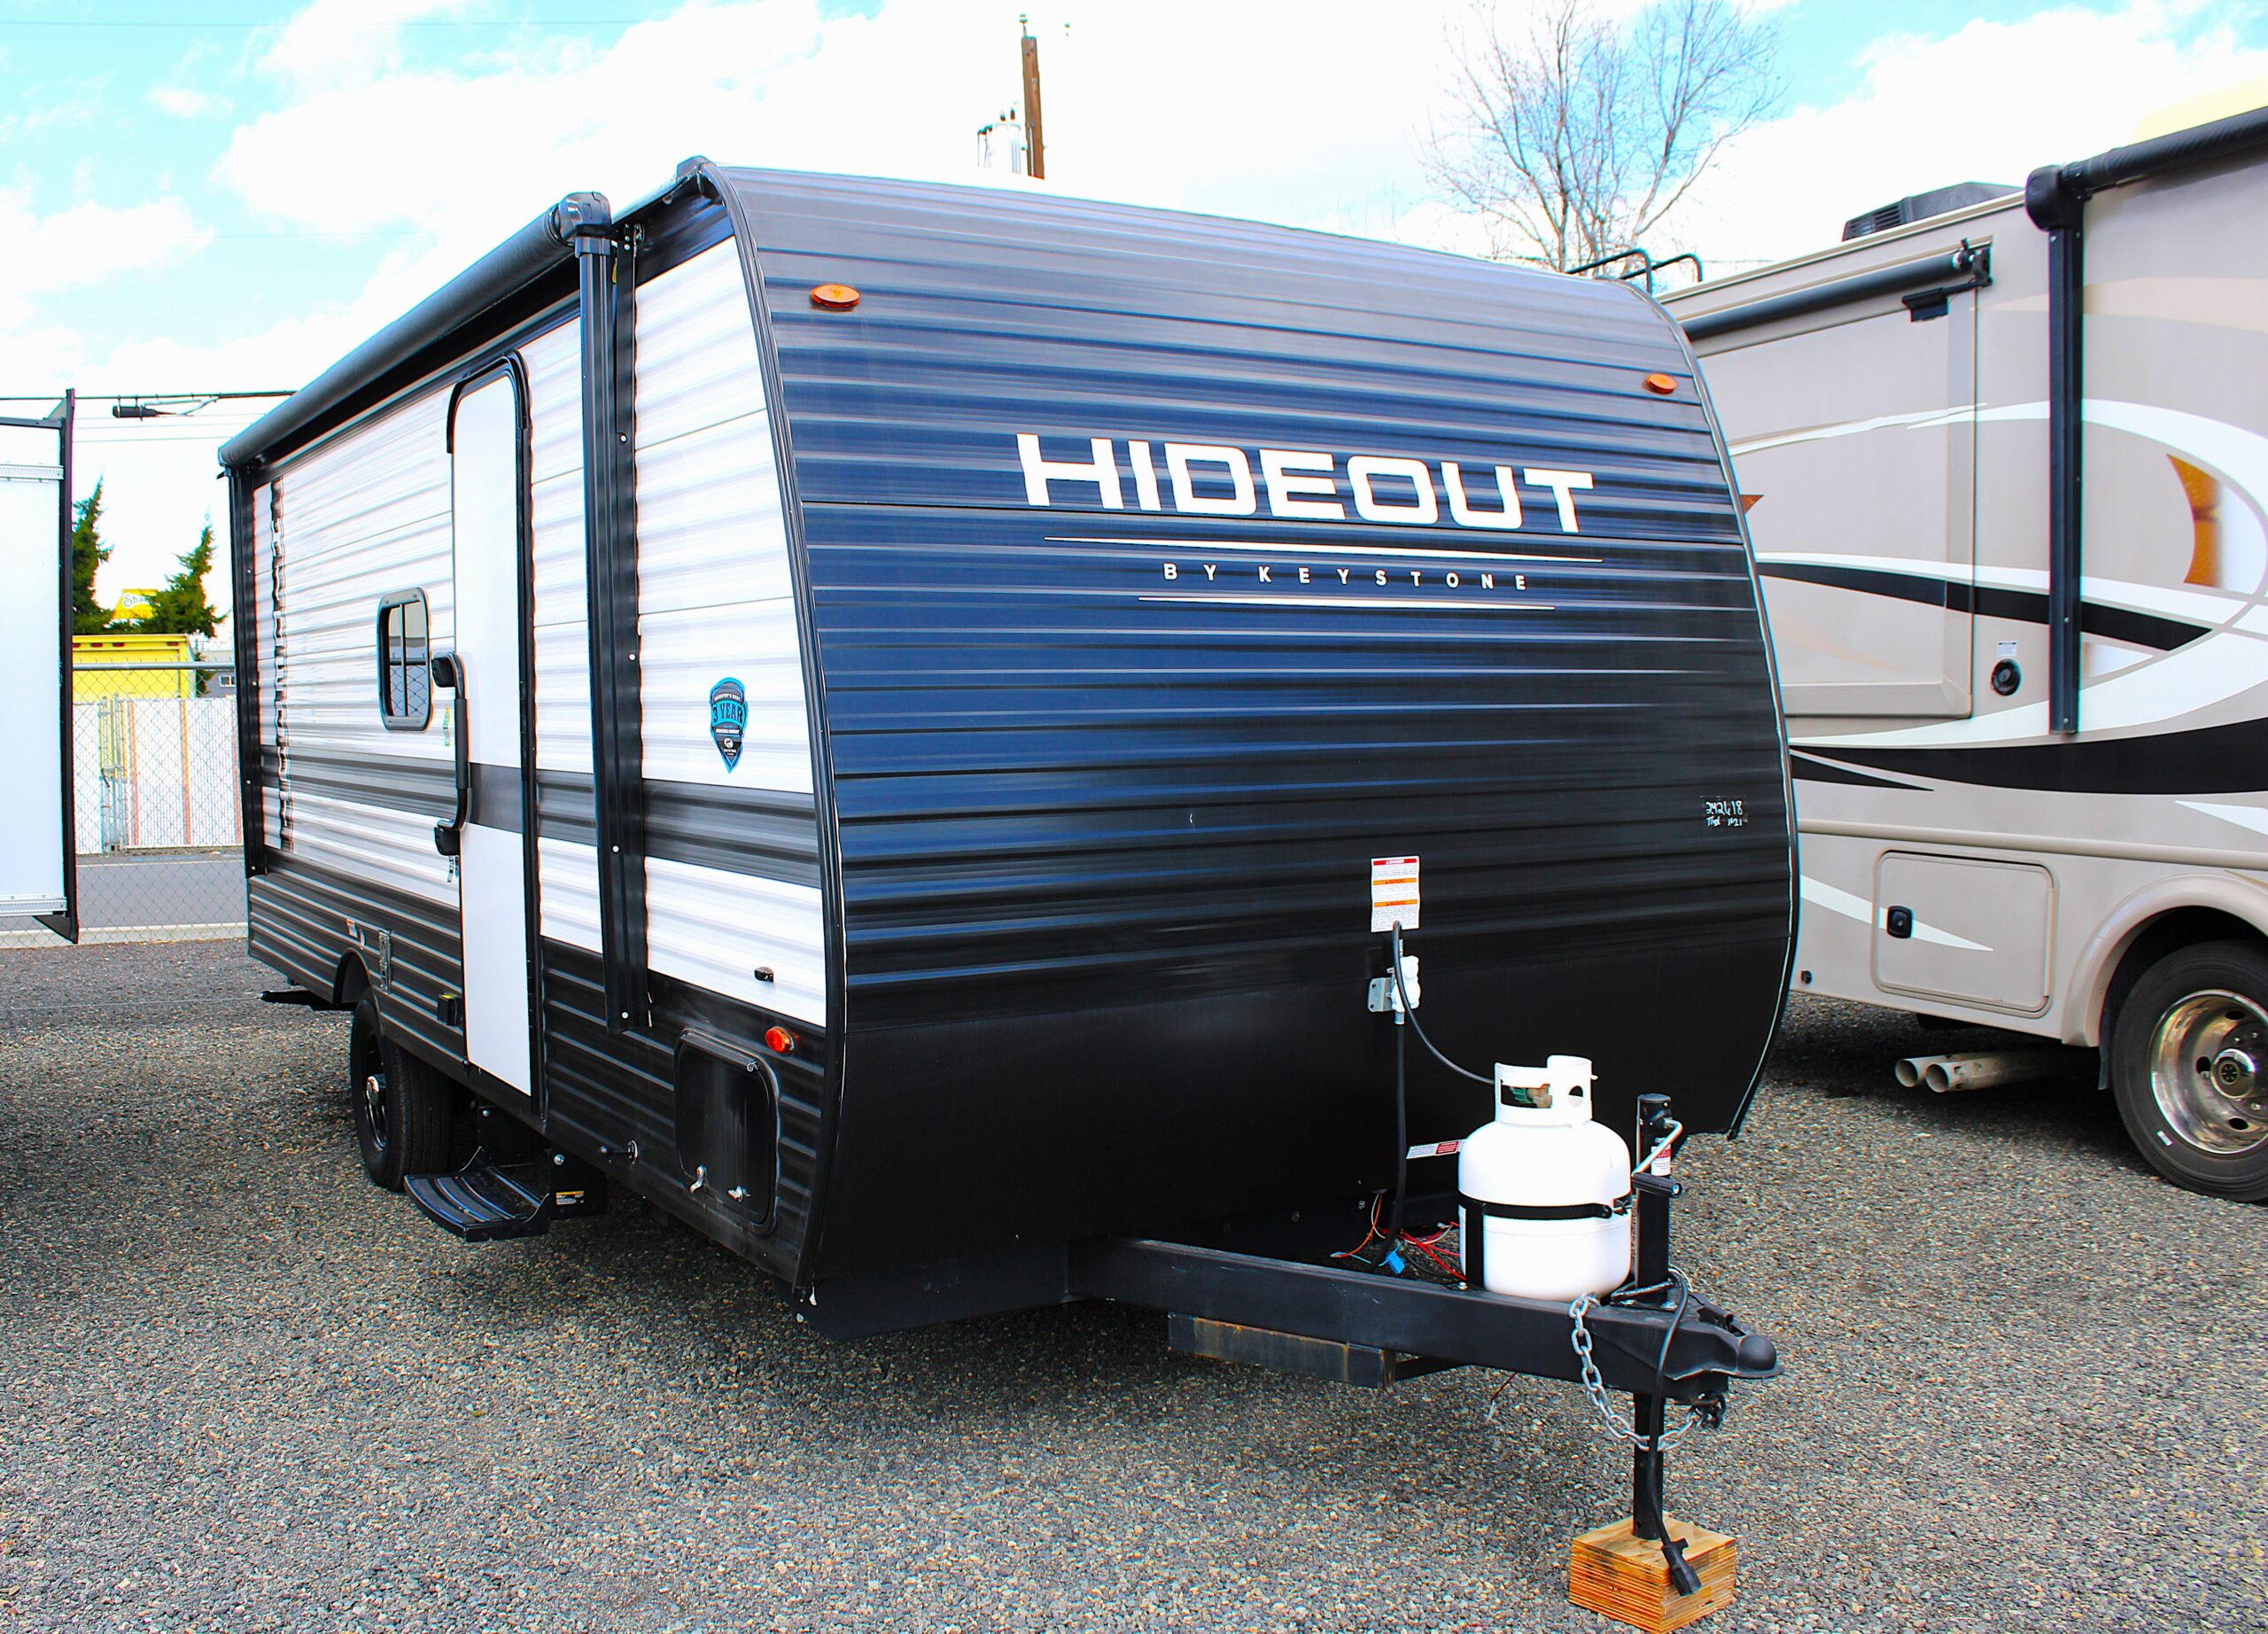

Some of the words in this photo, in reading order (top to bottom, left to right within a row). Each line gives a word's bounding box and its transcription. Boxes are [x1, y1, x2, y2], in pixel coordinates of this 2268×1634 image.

[1015, 433, 1595, 533] HIDEOUT
[1162, 563, 1217, 582] BY
[1257, 565, 1527, 591] KEYSTONE
[713, 706, 718, 723] 3
[719, 703, 743, 723] YEAR
